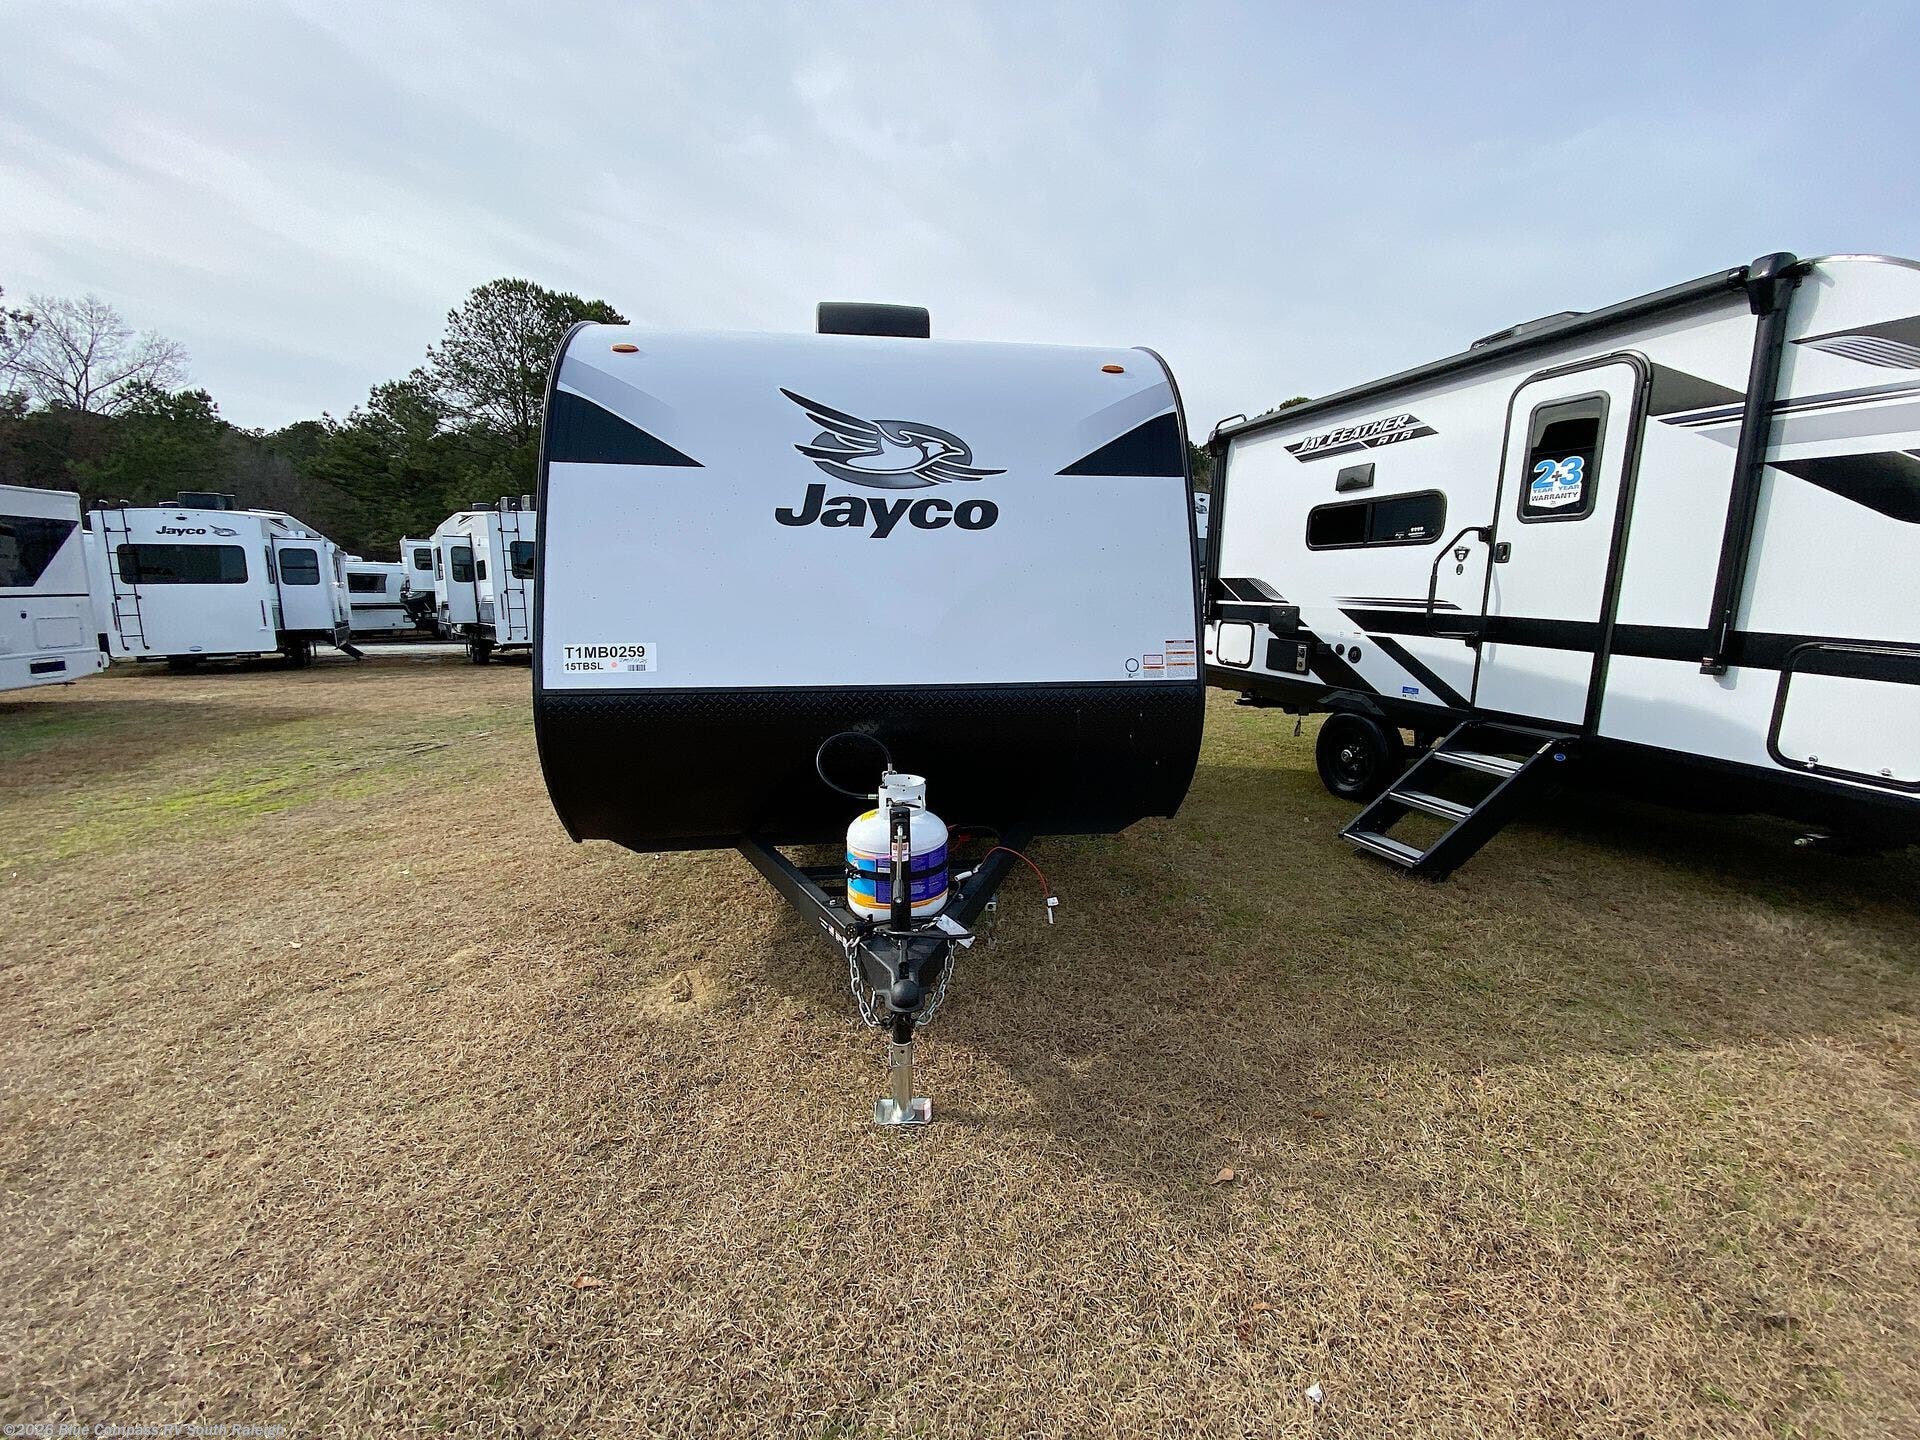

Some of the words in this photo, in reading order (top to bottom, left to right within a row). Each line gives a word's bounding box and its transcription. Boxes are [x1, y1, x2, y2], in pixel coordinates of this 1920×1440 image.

[1300, 436, 1328, 451] JAY
[1327, 414, 1410, 446] FEATHER
[1376, 429, 1414, 446] AIR
[1531, 491, 1579, 502] WARRANTY
[774, 483, 999, 539] Jayco
[156, 525, 207, 537] Jayco
[564, 645, 645, 659] T1MB0259
[564, 661, 604, 671] 15TBSL
